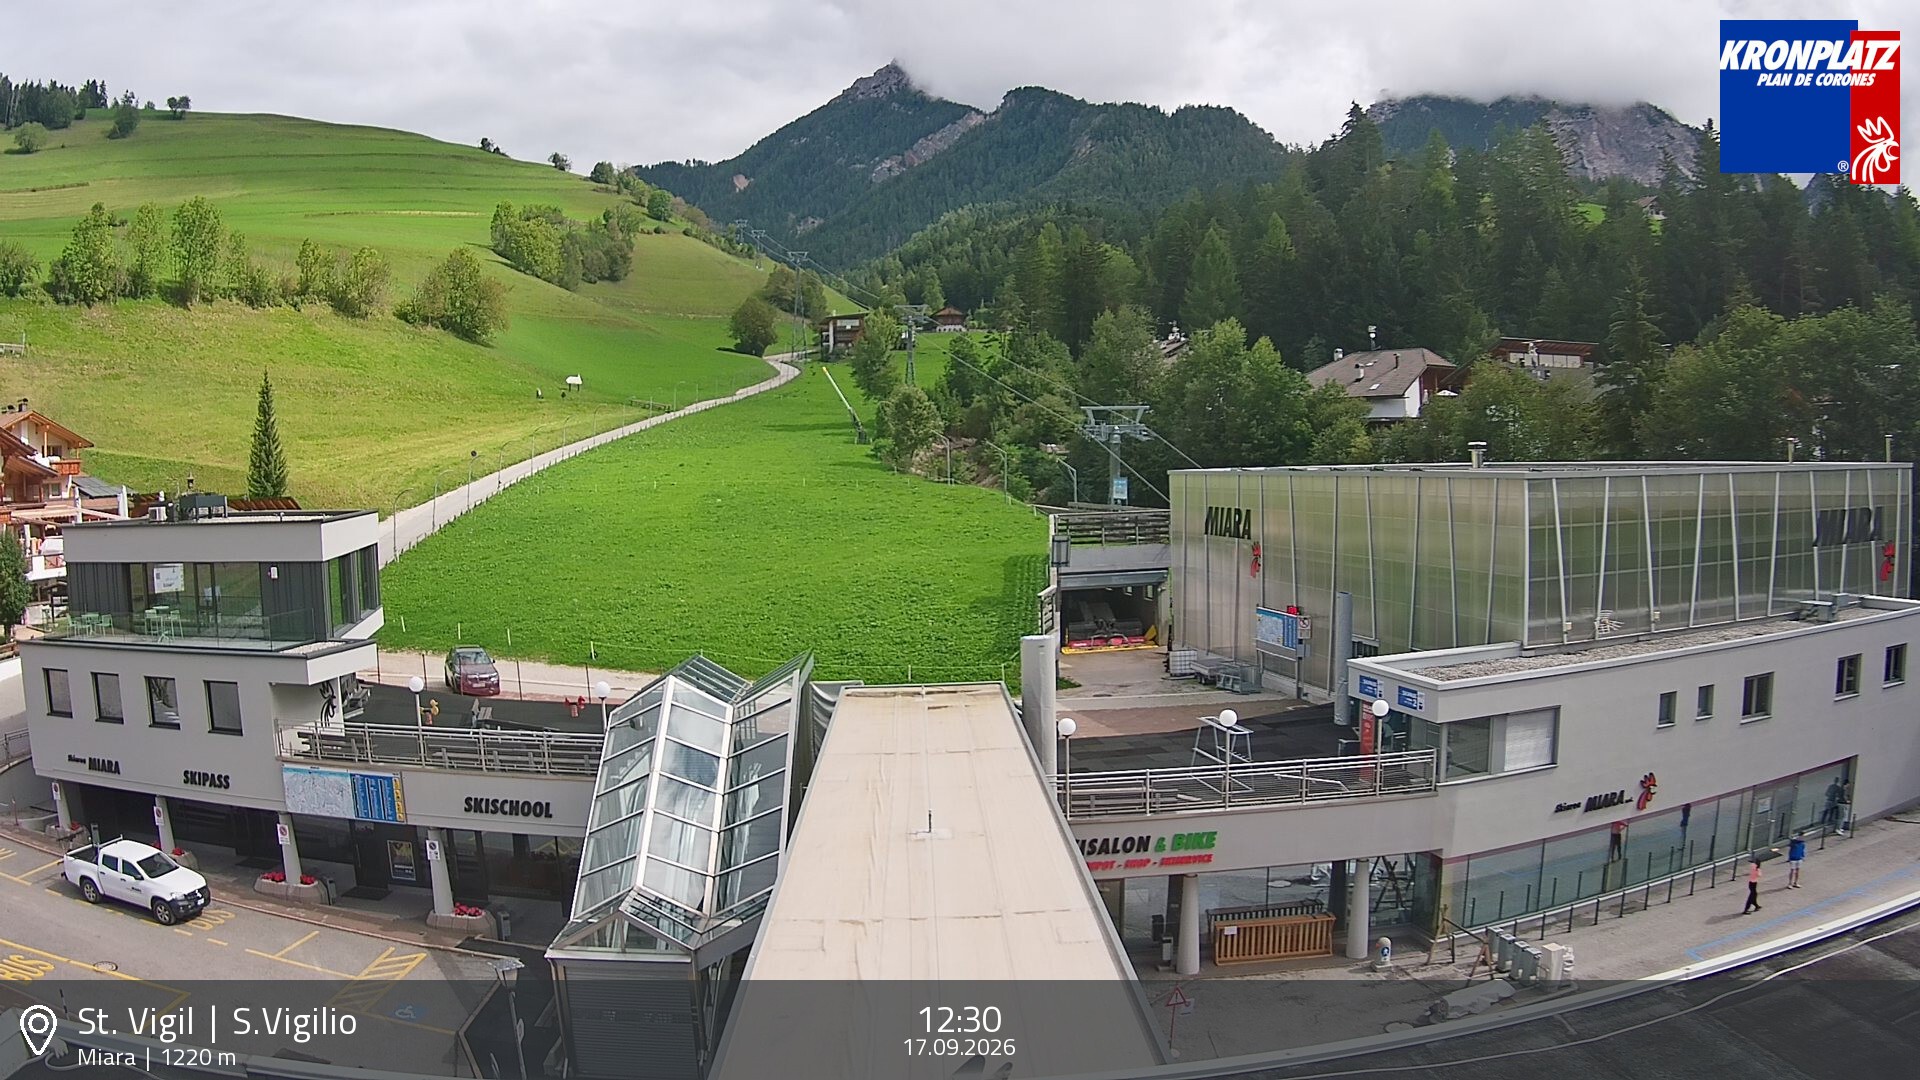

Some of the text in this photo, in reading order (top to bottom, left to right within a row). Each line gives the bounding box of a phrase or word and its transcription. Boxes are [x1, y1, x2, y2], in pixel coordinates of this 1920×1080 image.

[1205, 506, 1251, 540] MIARA
[88, 757, 120, 774] MIARA
[183, 769, 231, 790] SKIPASS
[464, 796, 553, 819] SKISCHOOL
[1584, 789, 1625, 813] MIARA
[1075, 831, 1217, 856] ISALON & BIKE
